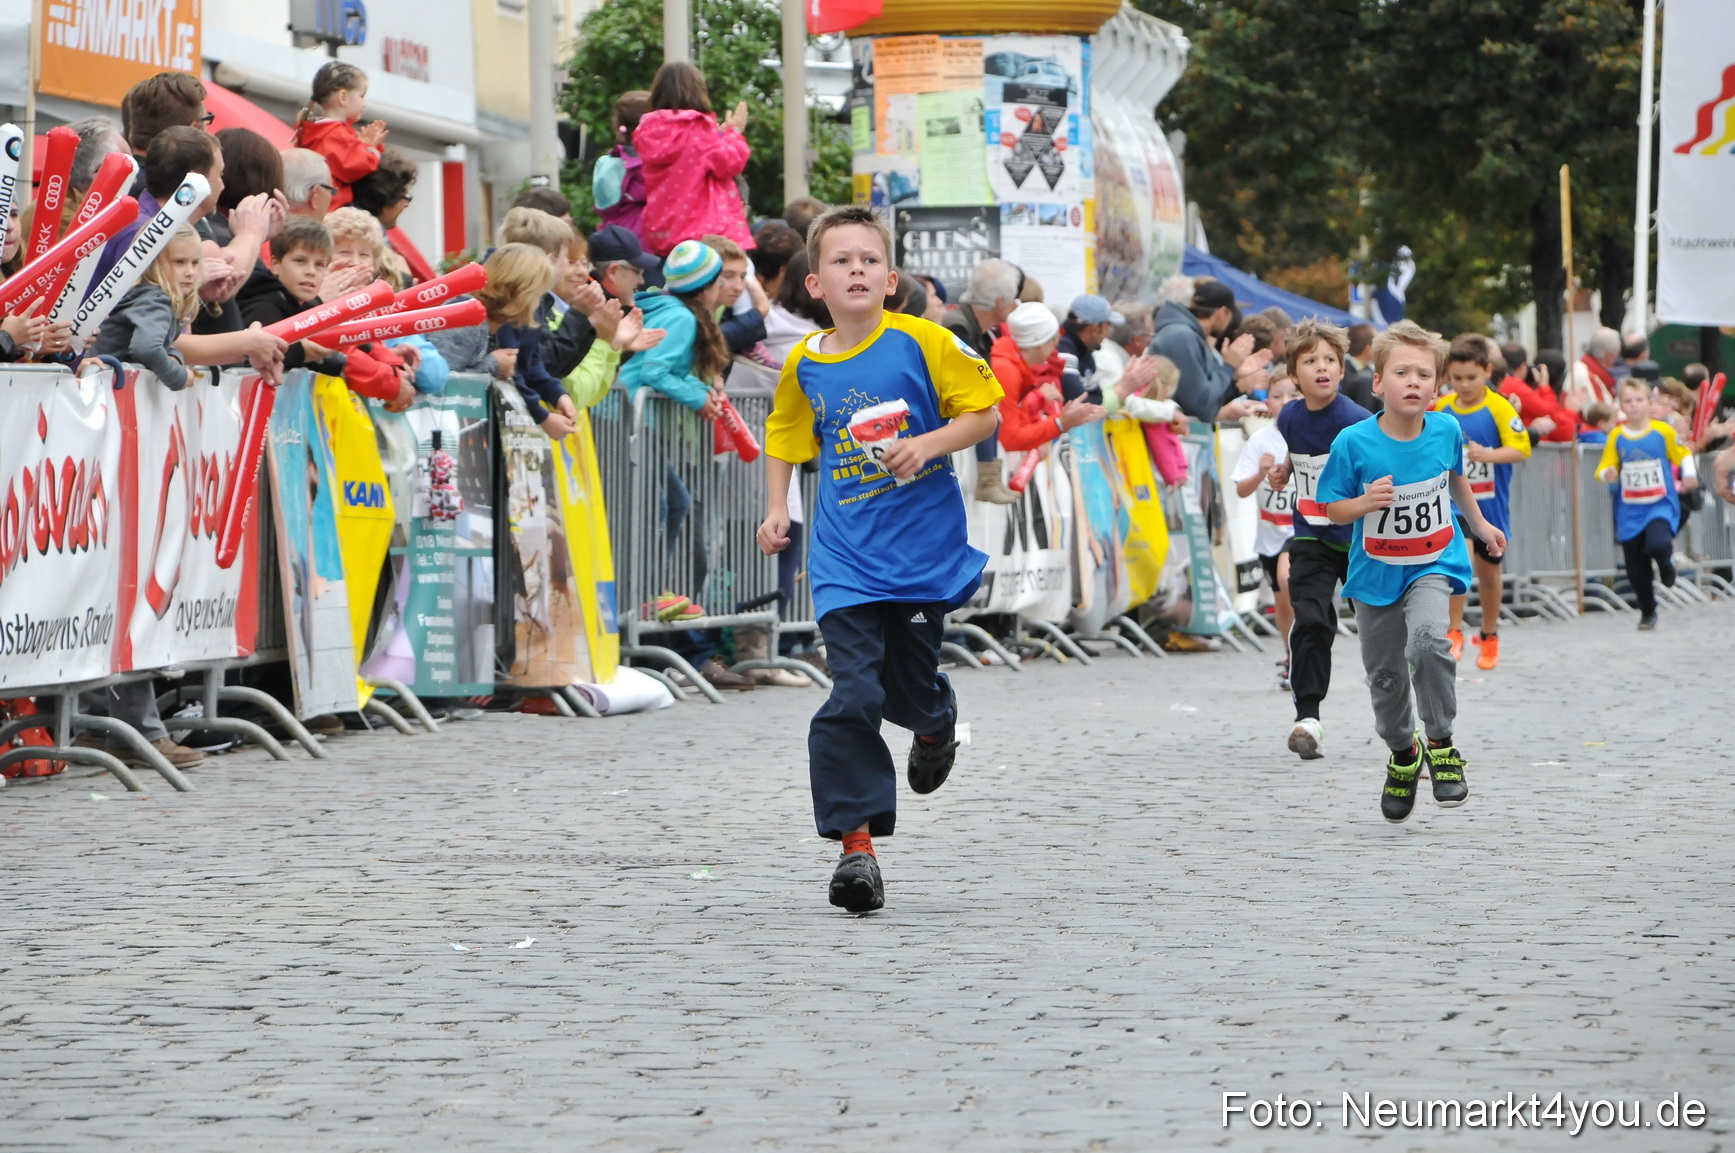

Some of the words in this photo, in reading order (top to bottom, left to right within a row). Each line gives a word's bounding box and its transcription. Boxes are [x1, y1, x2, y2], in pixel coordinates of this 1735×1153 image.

[36, 223, 53, 255] BKK
[132, 211, 174, 261] BMW
[4, 285, 36, 313] Audi
[37, 261, 67, 289] BKK
[70, 256, 138, 337] Laufsport
[293, 314, 319, 332] Audi
[318, 304, 342, 323] BKK
[338, 329, 371, 345] Audi
[374, 324, 403, 338] BKK
[1398, 484, 1439, 502] Neumarkt
[1624, 471, 1660, 488] 1214
[1377, 494, 1443, 535] 7581
[1374, 540, 1409, 552] Leon
